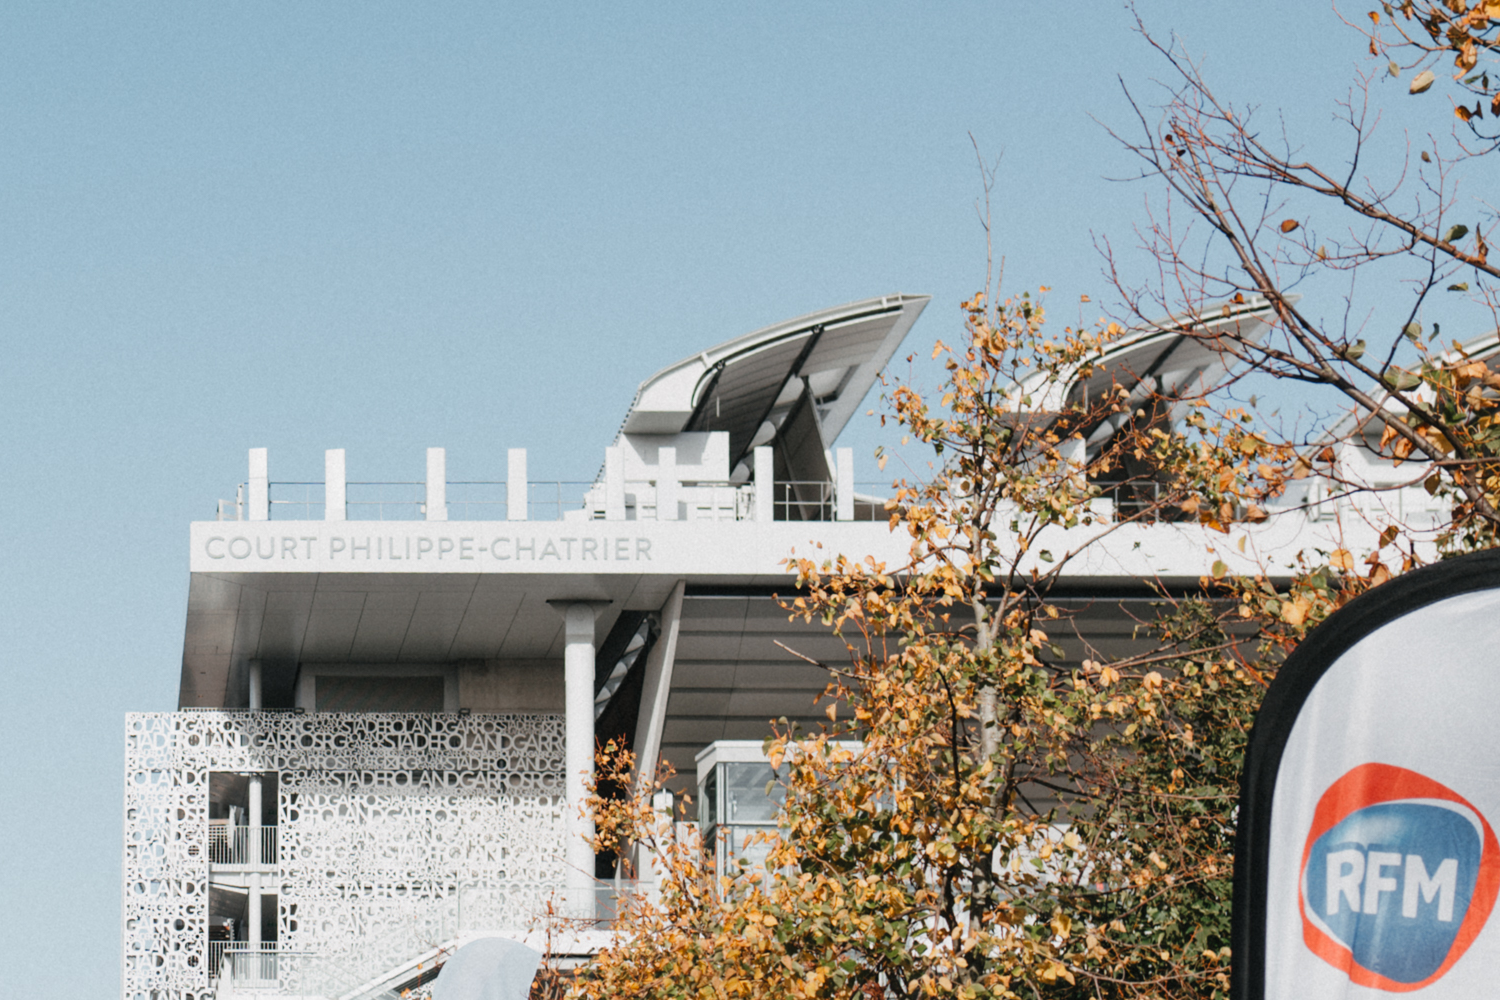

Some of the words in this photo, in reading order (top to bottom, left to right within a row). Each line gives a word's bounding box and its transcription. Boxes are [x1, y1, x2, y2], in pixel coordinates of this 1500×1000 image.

[204, 536, 318, 561] COURT
[329, 536, 654, 561] PHILIPPE-CHATRIER
[1325, 850, 1459, 923] RFM
